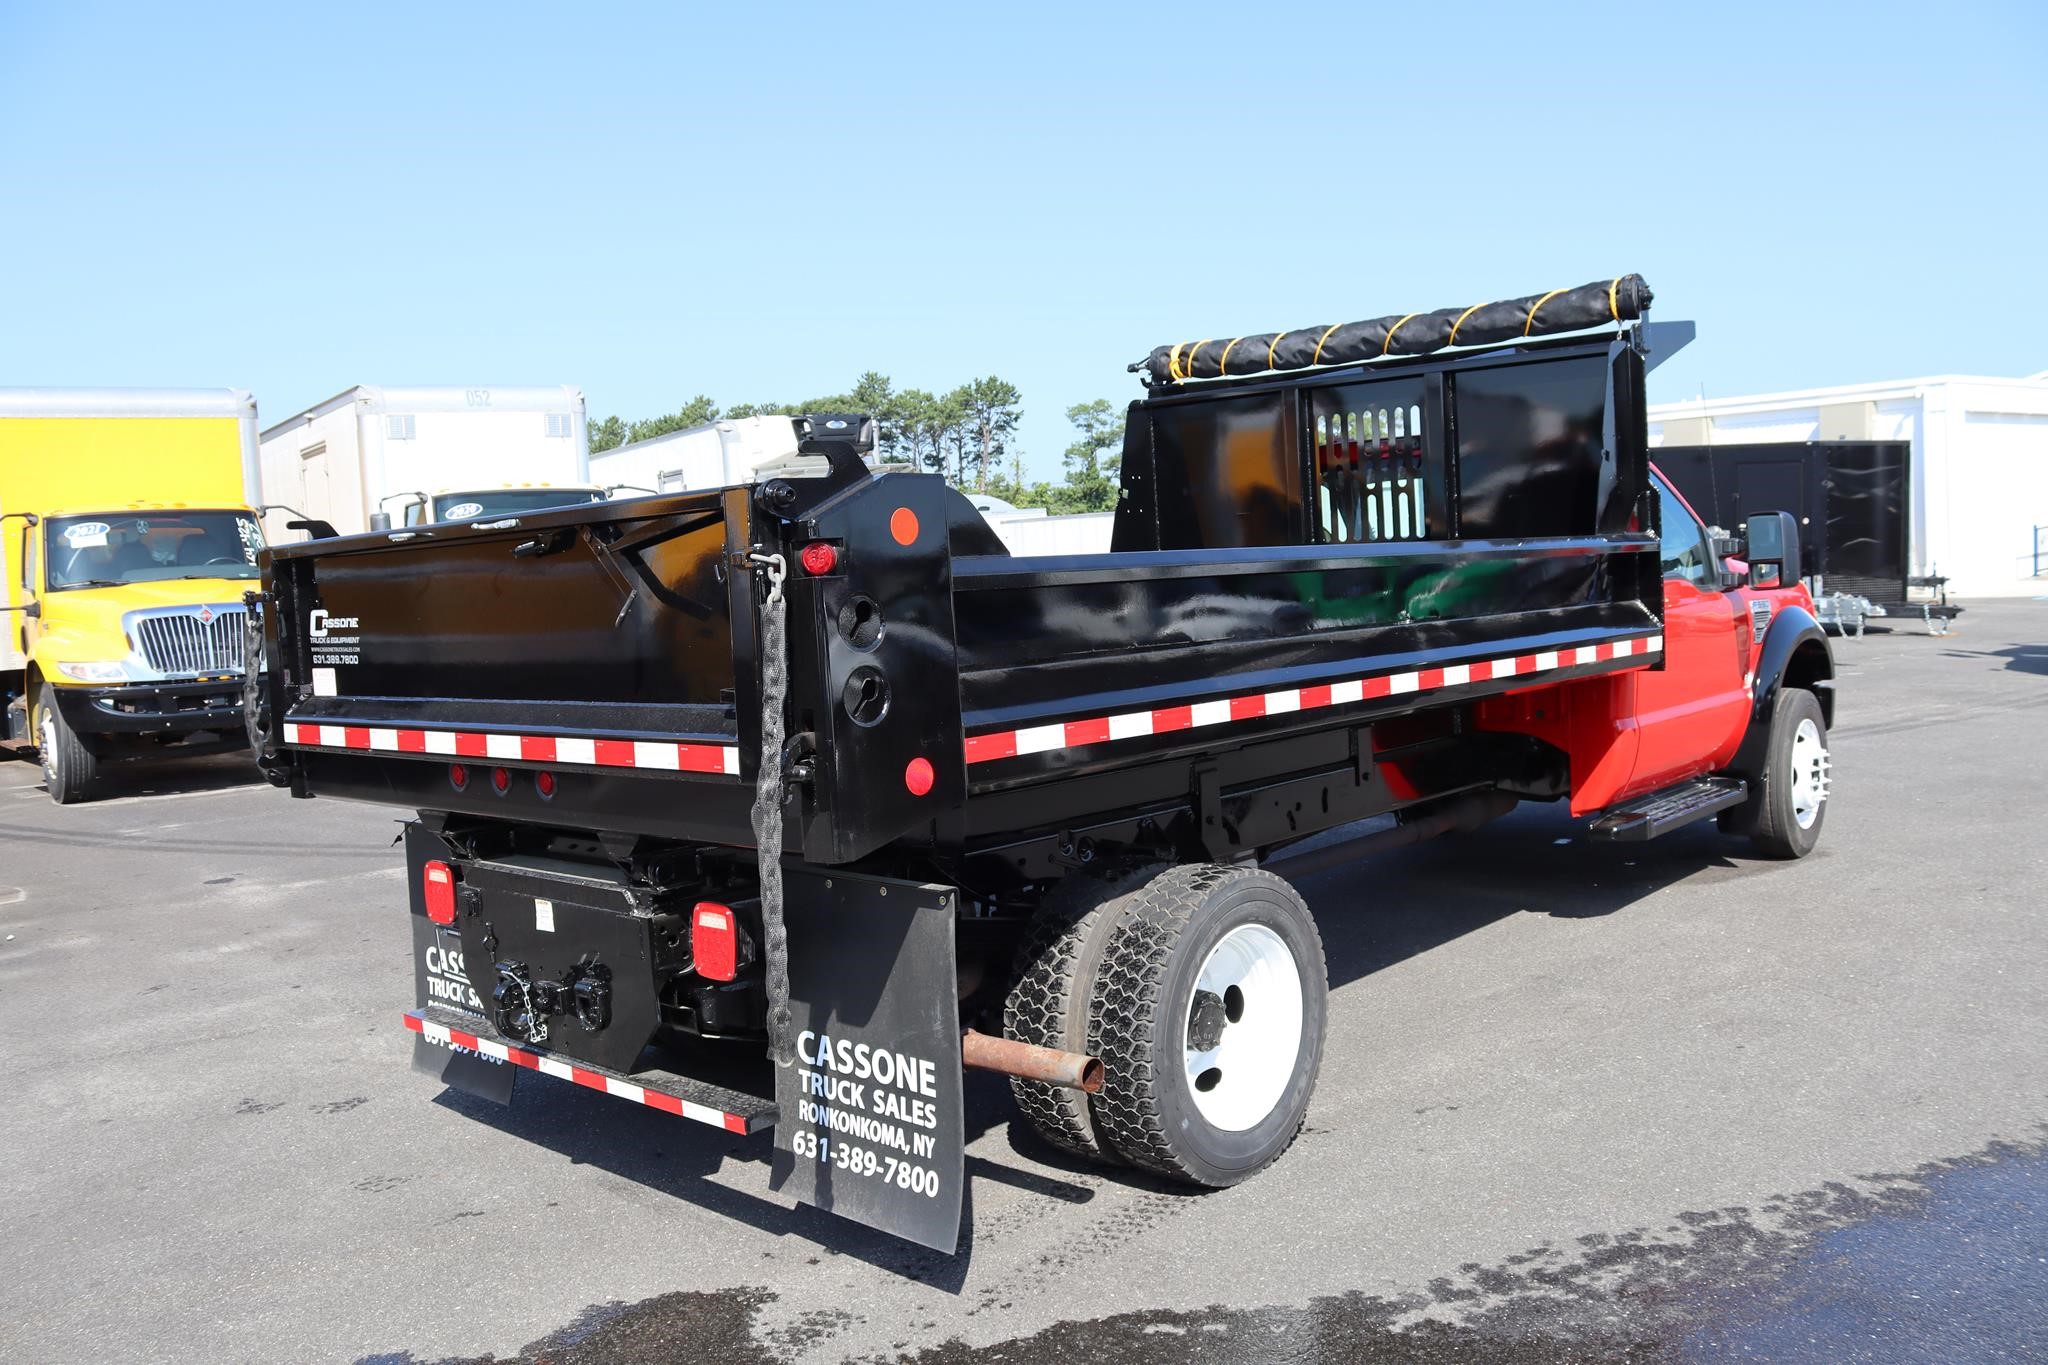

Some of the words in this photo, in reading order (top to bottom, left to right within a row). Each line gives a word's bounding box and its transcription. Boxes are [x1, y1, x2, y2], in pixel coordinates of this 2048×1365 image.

[465, 389, 493, 407] 052
[313, 655, 359, 664] 631.389.7800
[427, 976, 465, 1003] TRUCK
[797, 1030, 937, 1099] CASSONE
[798, 1069, 865, 1110] TRUCK
[873, 1089, 937, 1129] SALES
[799, 1099, 910, 1155] RONKONKOMA,
[913, 1132, 936, 1159] NY
[792, 1130, 940, 1198] 631-389-7800
